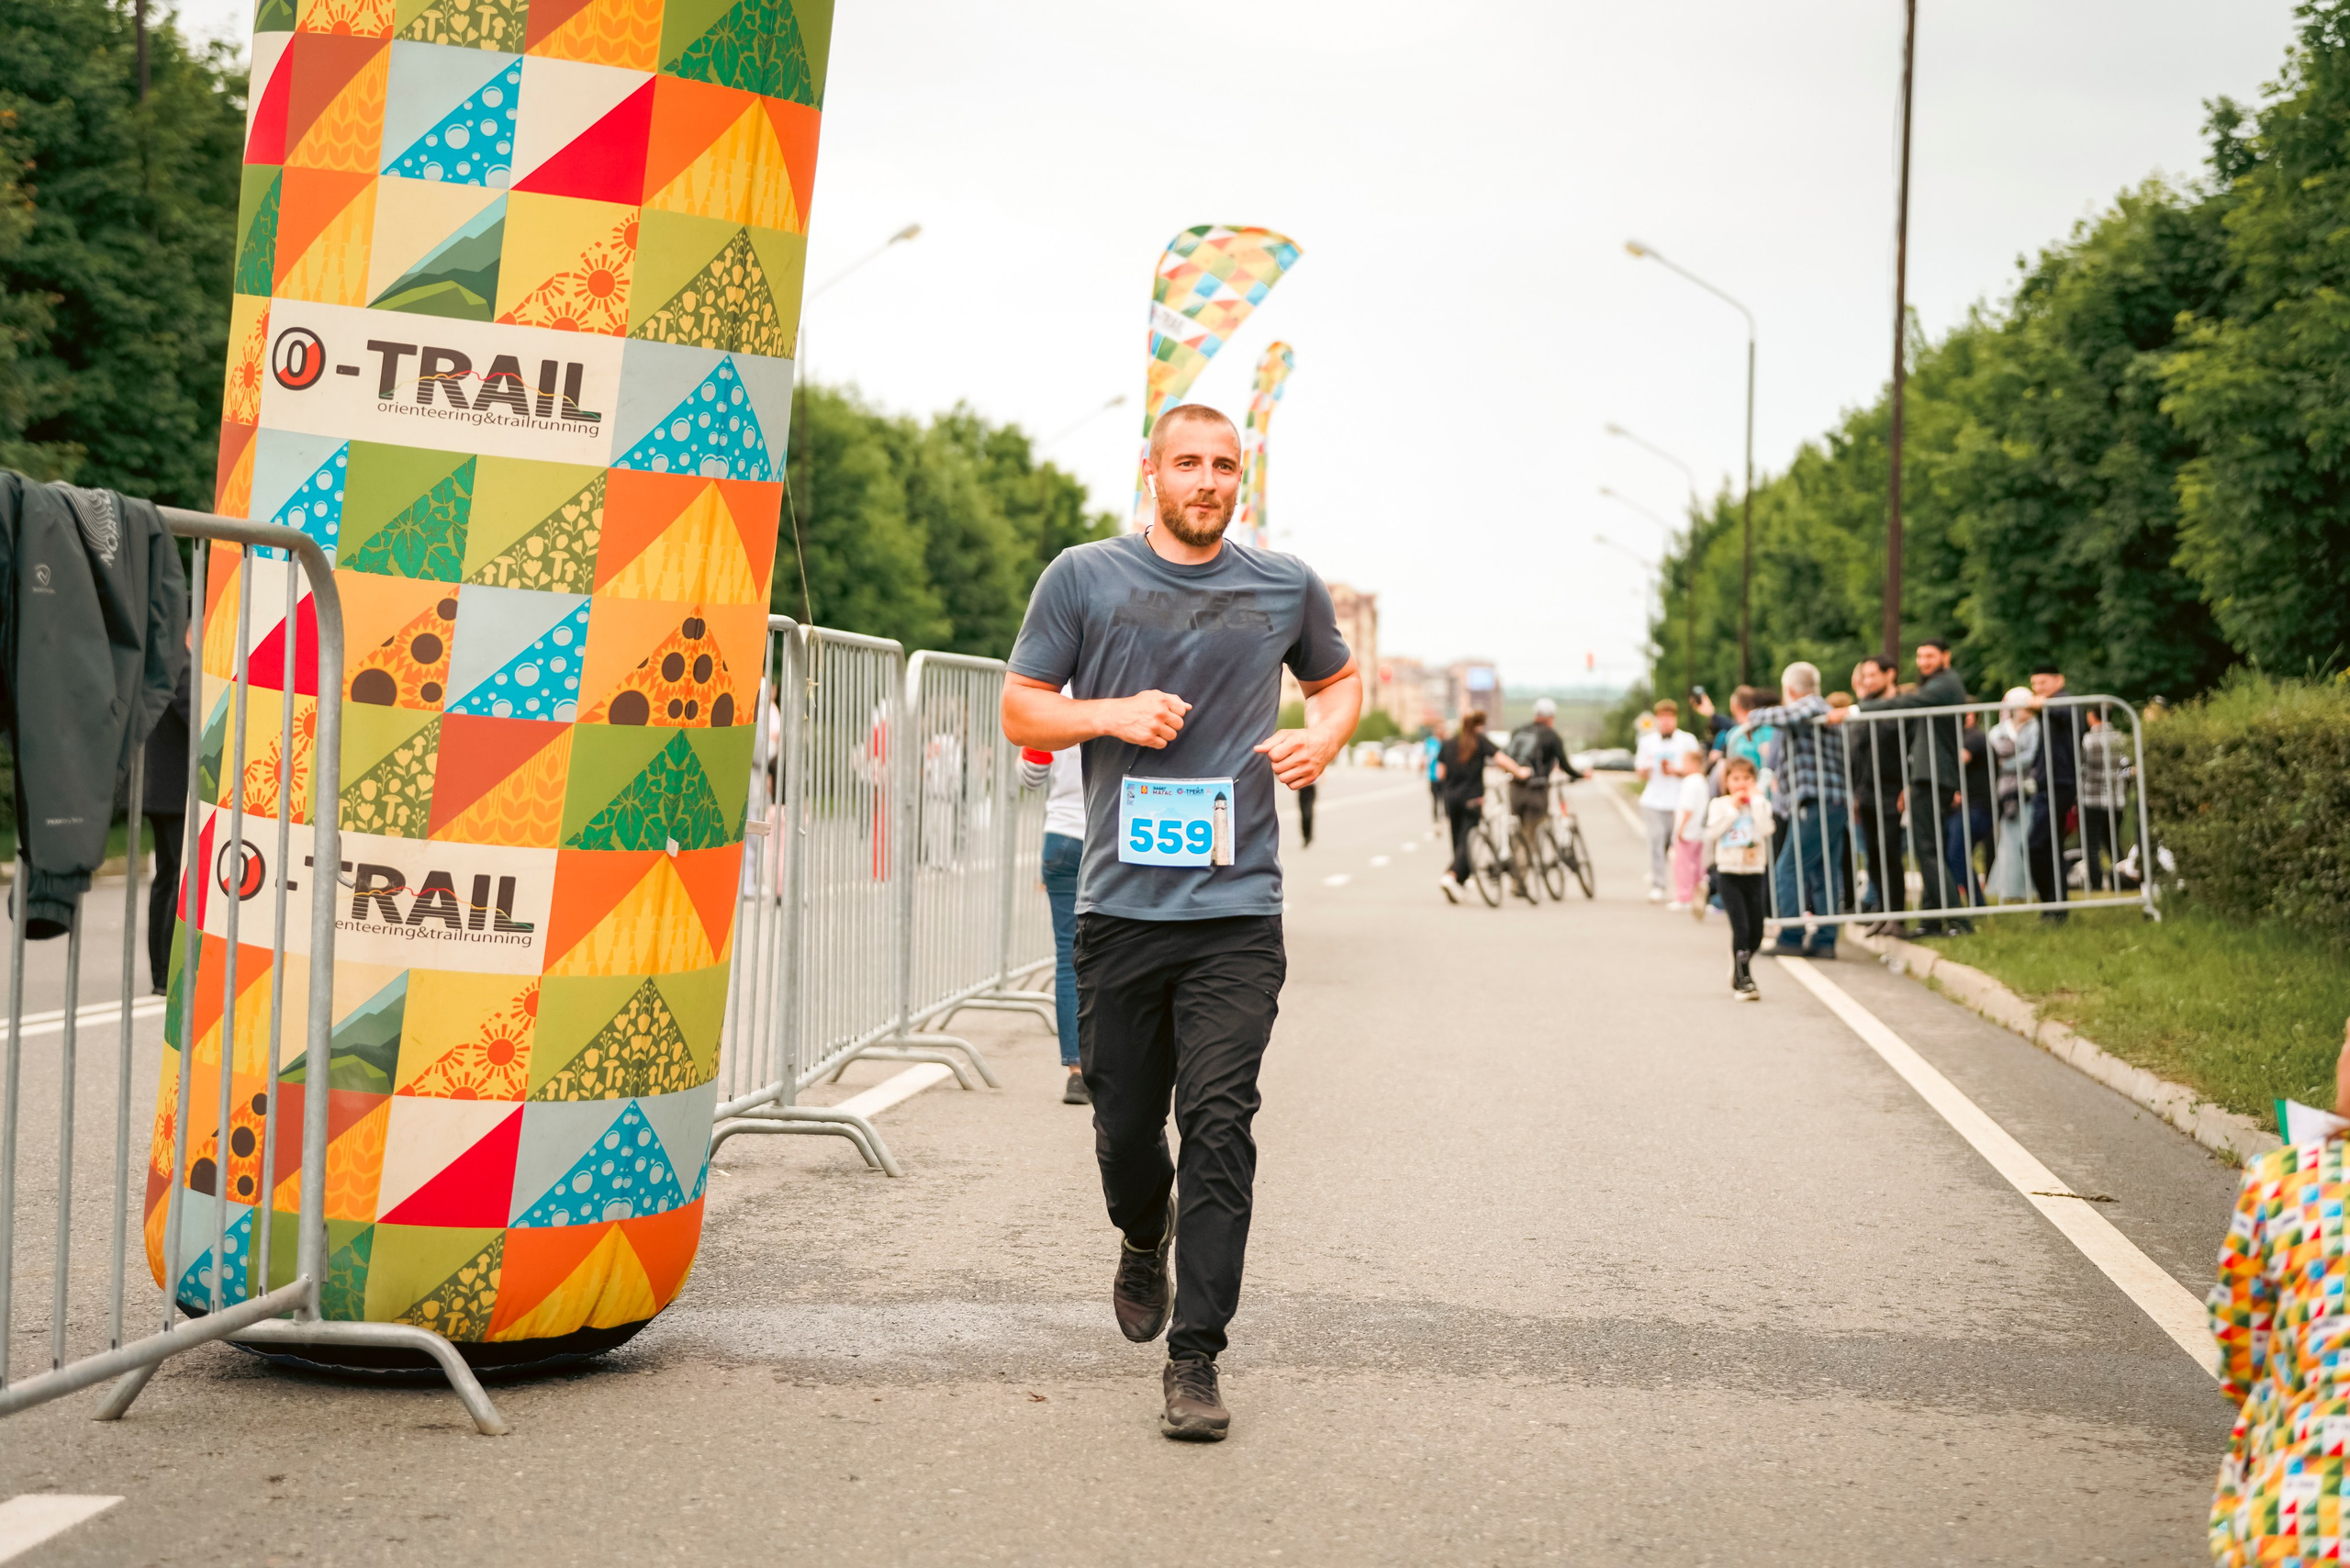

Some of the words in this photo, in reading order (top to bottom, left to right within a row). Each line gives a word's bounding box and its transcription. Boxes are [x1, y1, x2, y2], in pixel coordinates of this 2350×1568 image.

[377, 401, 600, 438] orienteering&trailrunning
[1129, 818, 1213, 855] 559
[334, 918, 533, 948] enteering&trailrunning
